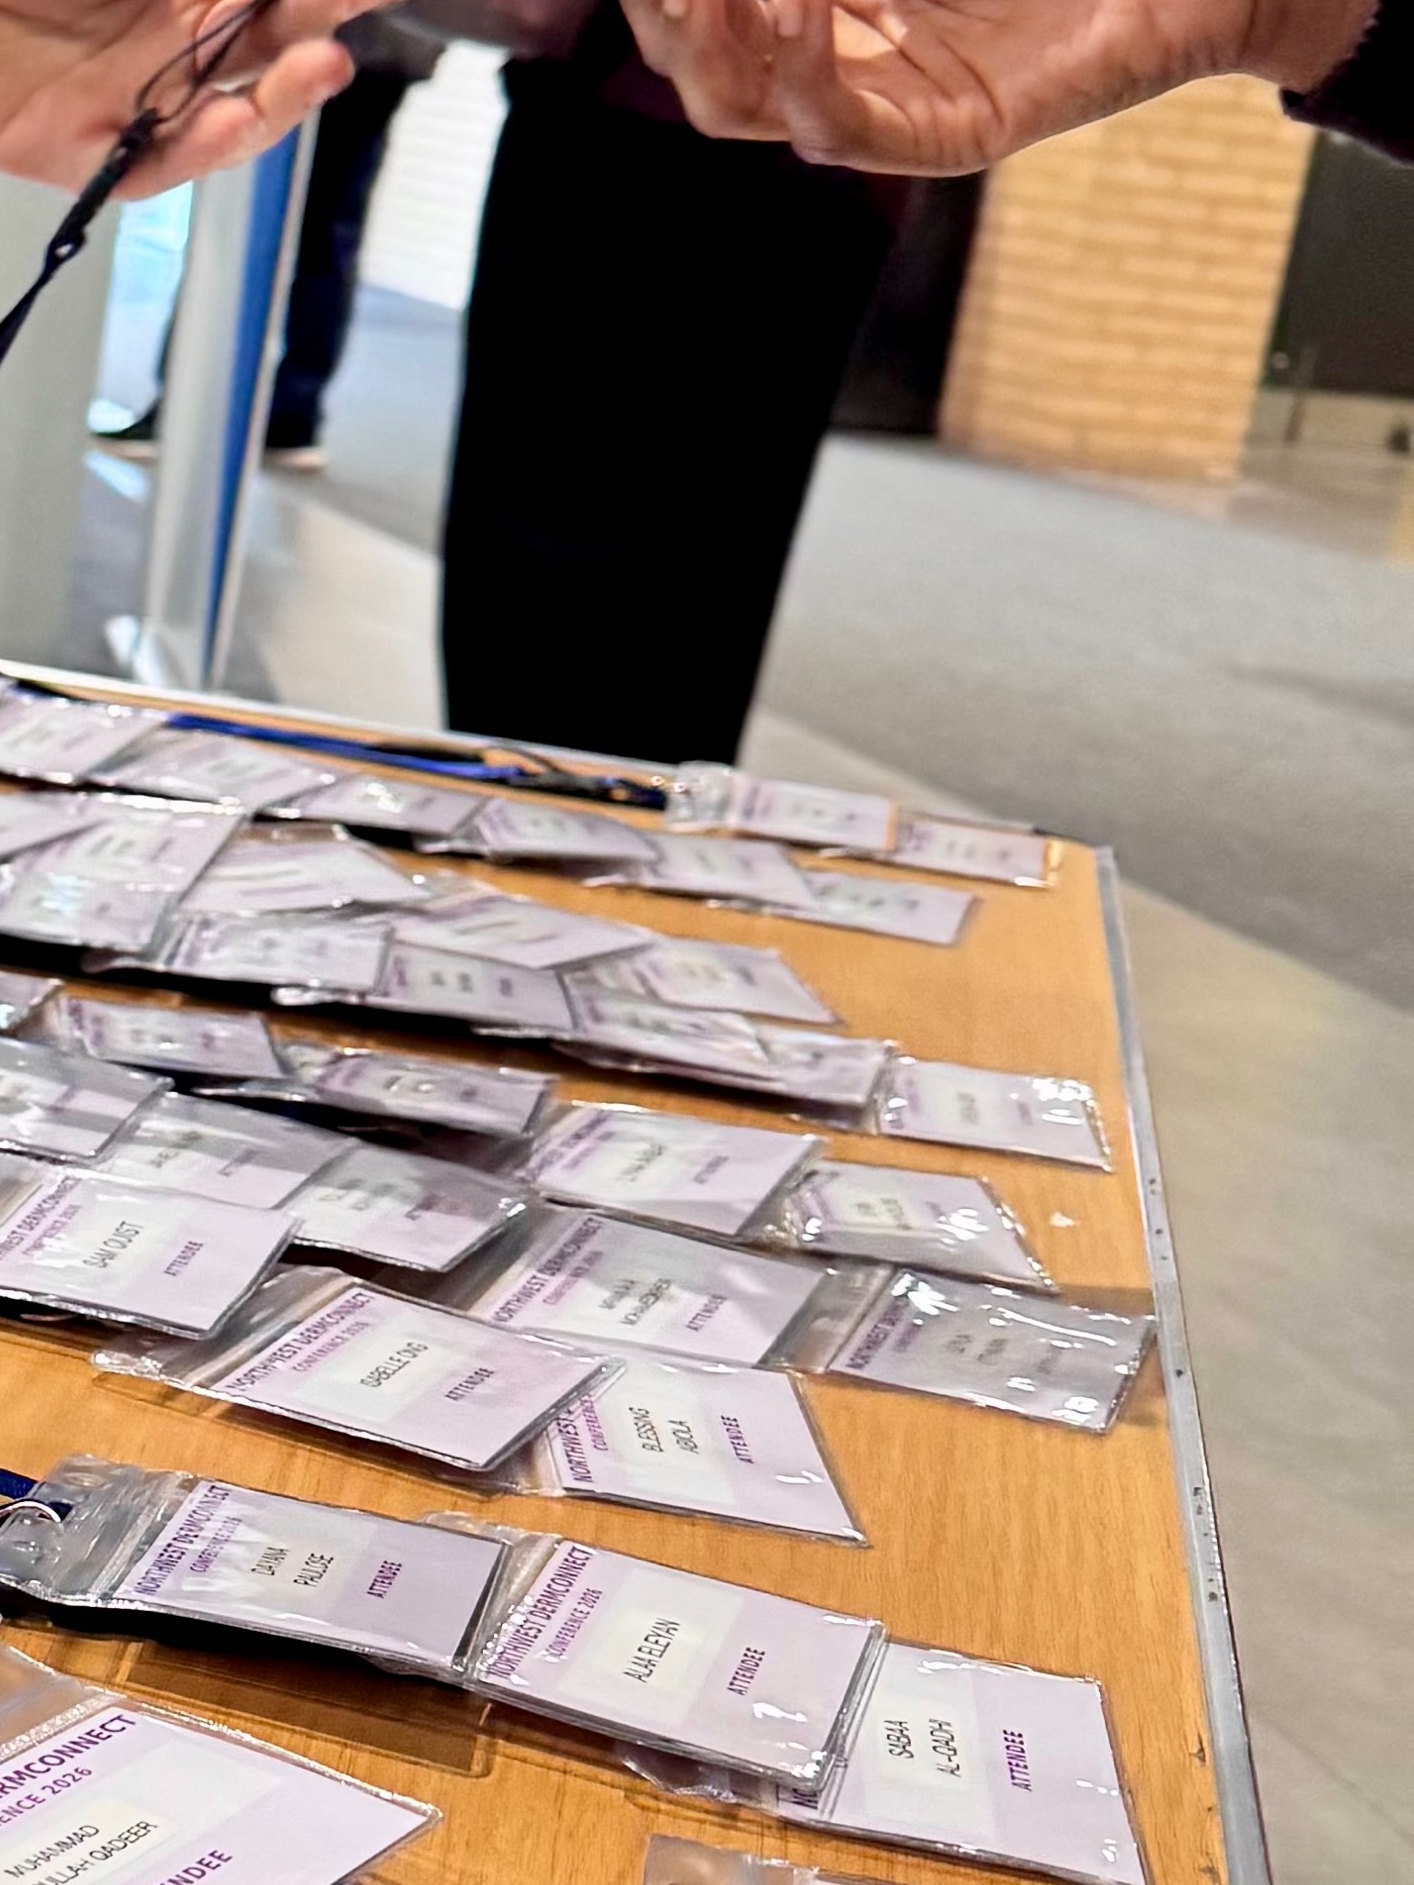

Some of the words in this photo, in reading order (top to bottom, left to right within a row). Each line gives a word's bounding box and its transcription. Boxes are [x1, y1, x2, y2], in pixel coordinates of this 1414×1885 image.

[165, 1242, 203, 1277] ATTENDEE
[494, 1274, 549, 1323] NORTHWEST
[226, 1341, 300, 1392] NORTHWEST
[297, 1293, 372, 1346] DERMCONNECT
[445, 1367, 495, 1401] ATTENDEE
[721, 1416, 754, 1463] ATTENDEE
[134, 1539, 185, 1596] NORTHWEST
[176, 1485, 233, 1546] DERMCONNECT
[367, 1560, 404, 1599] ATTENDEE
[537, 1547, 595, 1620] DERMCONNECT
[726, 1646, 766, 1695] ATTENDEE
[42, 1766, 93, 1795] 2026
[1004, 1726, 1033, 1791] ATTENDEE
[4, 1824, 100, 1878] MUHAMMAD
[89, 1820, 157, 1861] QADEER
